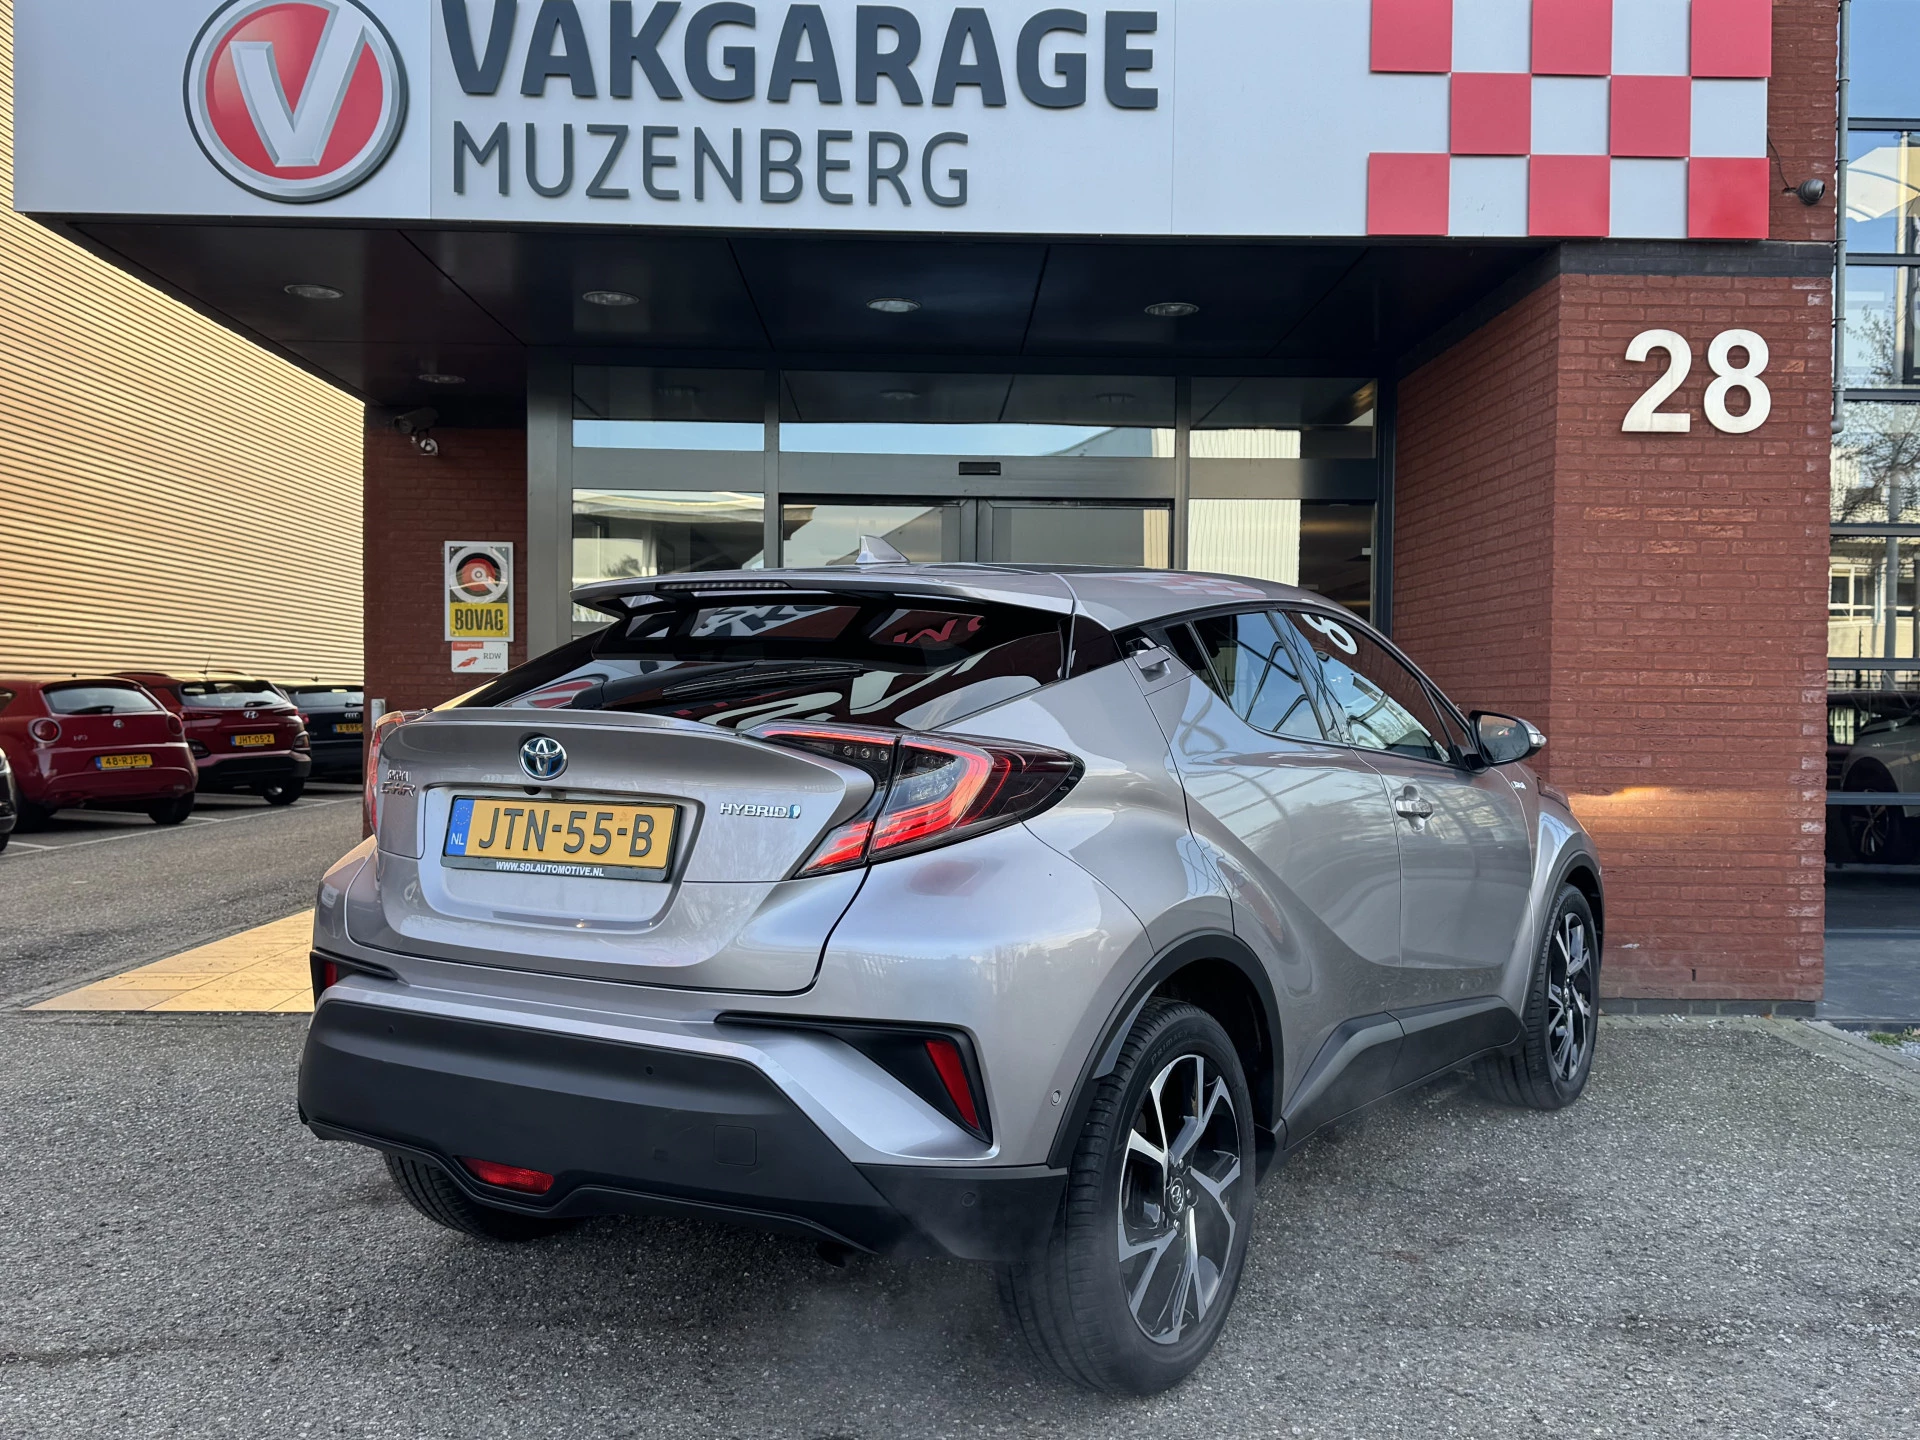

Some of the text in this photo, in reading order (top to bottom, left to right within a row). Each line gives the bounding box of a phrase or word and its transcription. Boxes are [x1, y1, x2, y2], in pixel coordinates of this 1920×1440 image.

[441, 0, 1158, 109] VAKGARAGE
[453, 120, 969, 208] MUZENBERG
[1621, 328, 1772, 435] 28
[455, 608, 503, 631] BOVAG
[483, 652, 502, 660] RDW
[105, 755, 148, 766] 48-RJF-9
[720, 802, 787, 818] HYBRID
[451, 832, 464, 846] NL
[478, 807, 655, 858] JTN-55-B
[496, 861, 604, 877] WWW.SDLAUTOMOTIVE.NL
